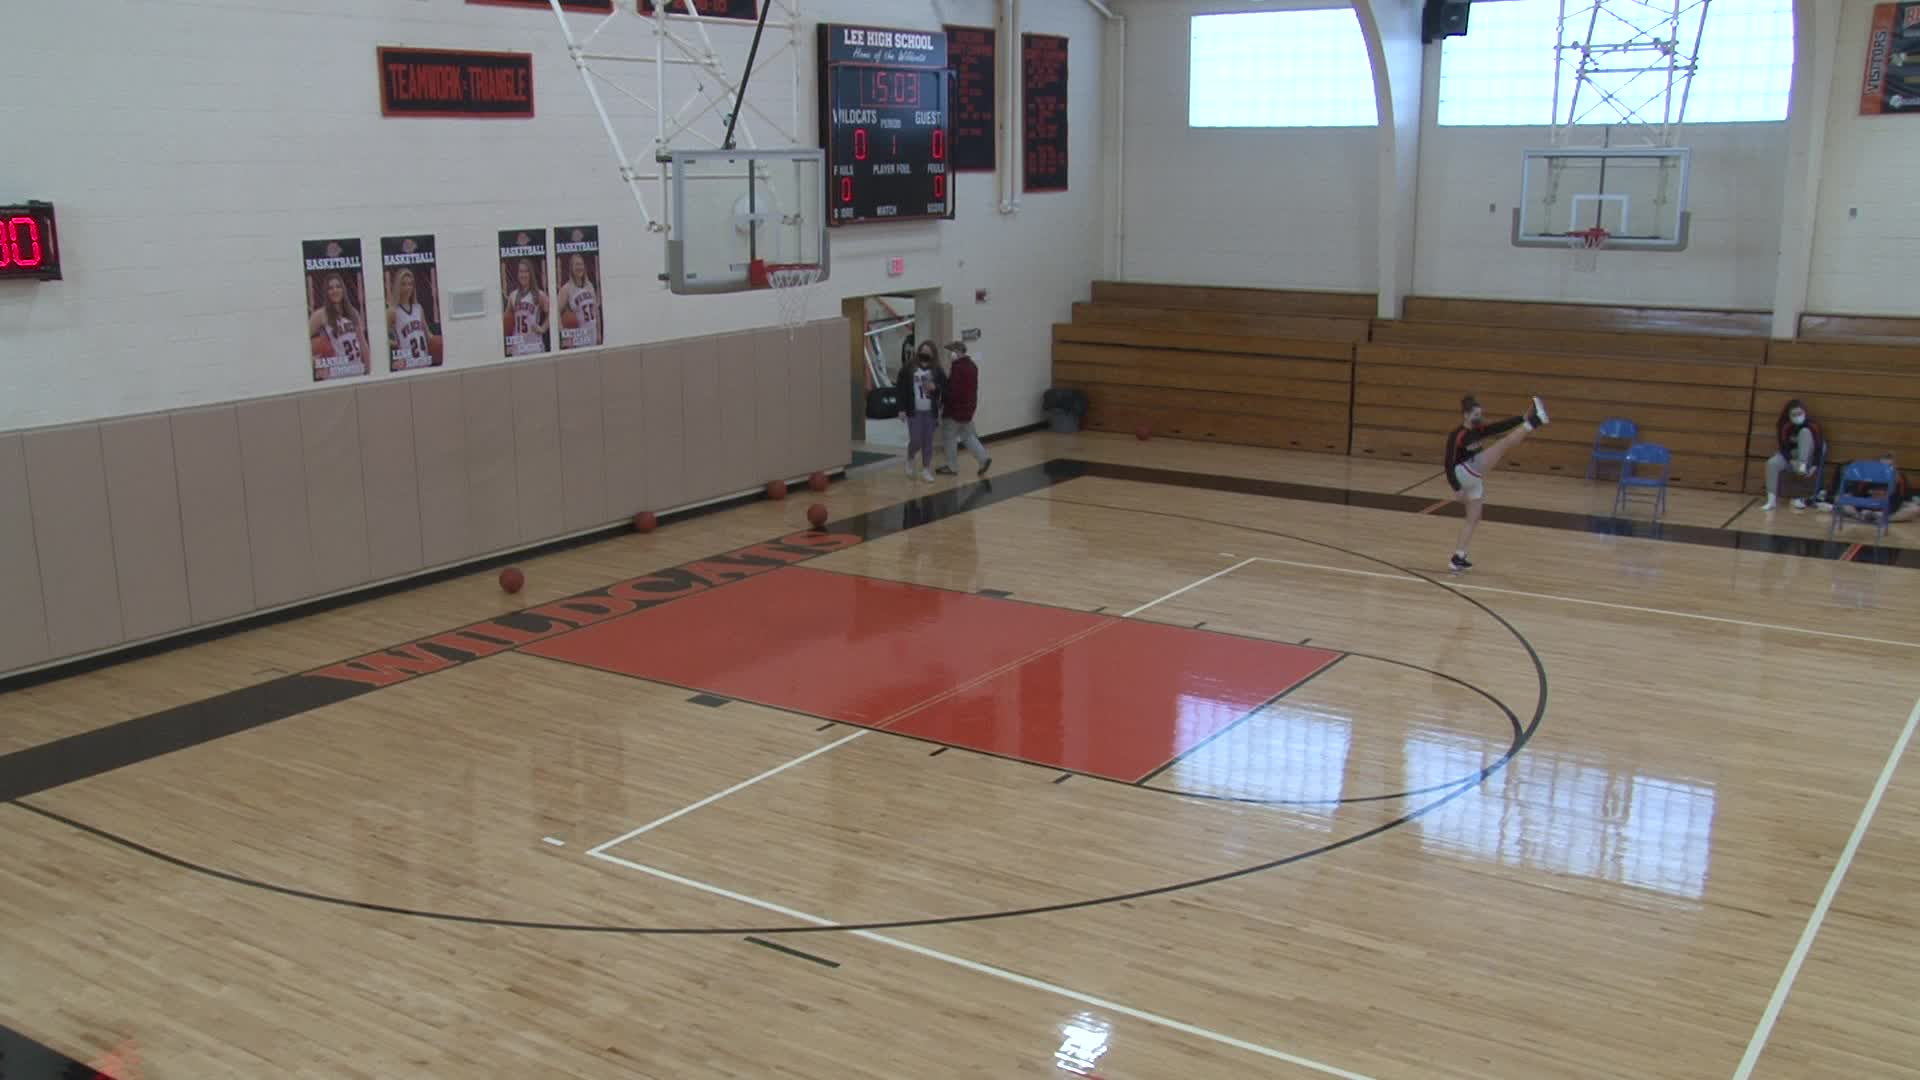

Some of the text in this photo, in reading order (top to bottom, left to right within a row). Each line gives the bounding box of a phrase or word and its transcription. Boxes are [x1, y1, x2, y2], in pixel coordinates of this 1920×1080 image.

[844, 29, 865, 46] LEE
[866, 31, 893, 48] HIGH
[894, 33, 934, 51] SCHOOL
[915, 111, 942, 125] GUEST
[854, 128, 868, 160] 0
[932, 128, 945, 160] 0
[841, 176, 852, 203] 0
[934, 174, 944, 199] 0
[500, 245, 546, 257] BASKETBALL
[556, 241, 598, 253] BASKETBALL
[305, 256, 361, 270] BASKETBALL
[384, 252, 435, 265] BASKETBALL
[316, 531, 863, 686] WILDCATS
